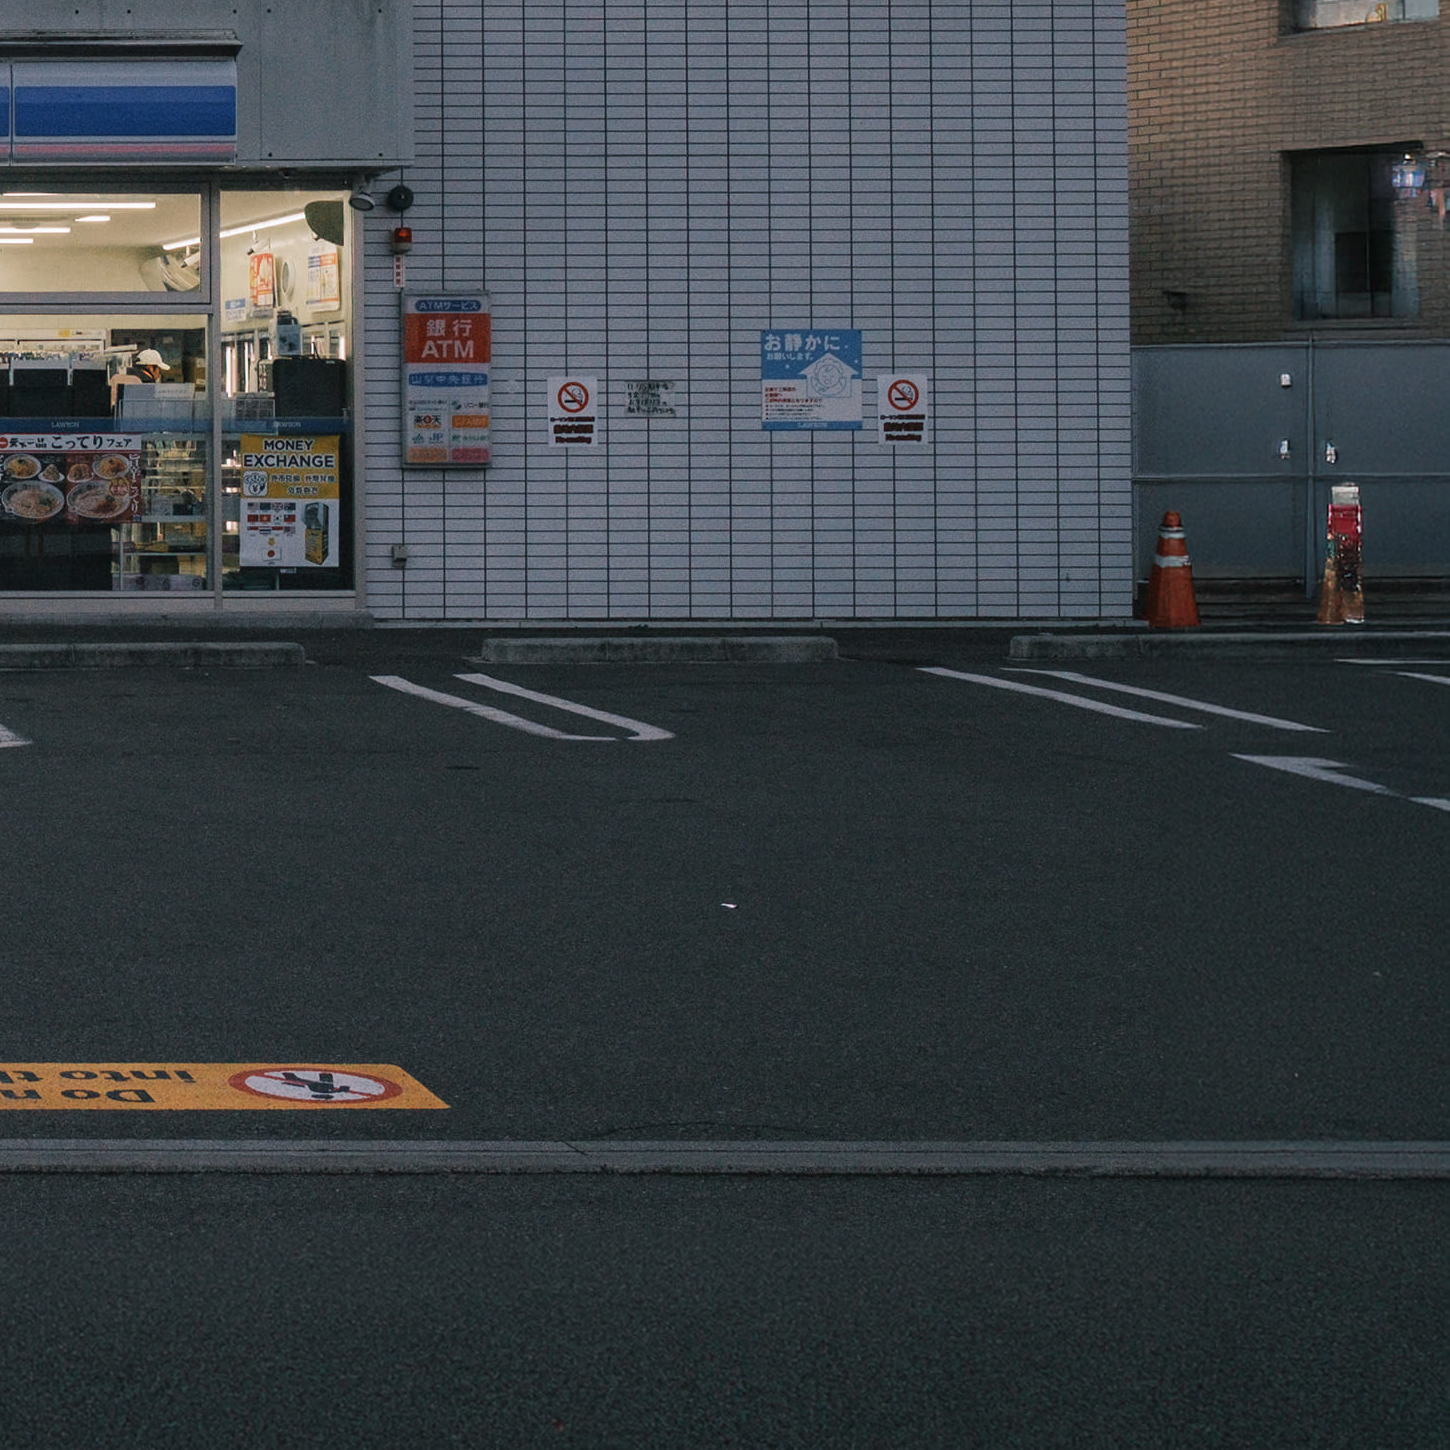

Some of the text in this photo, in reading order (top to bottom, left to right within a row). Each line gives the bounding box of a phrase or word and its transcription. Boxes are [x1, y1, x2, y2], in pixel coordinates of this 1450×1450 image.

[419, 301, 478, 310] ATMサービス
[426, 319, 473, 337] 銀行
[421, 340, 475, 358] ATM
[764, 333, 841, 351] お静かに
[263, 440, 314, 451] MONEY
[243, 454, 334, 468] EXCHANGE
[61, 1068, 195, 1084] into
[61, 1089, 156, 1102] Do
